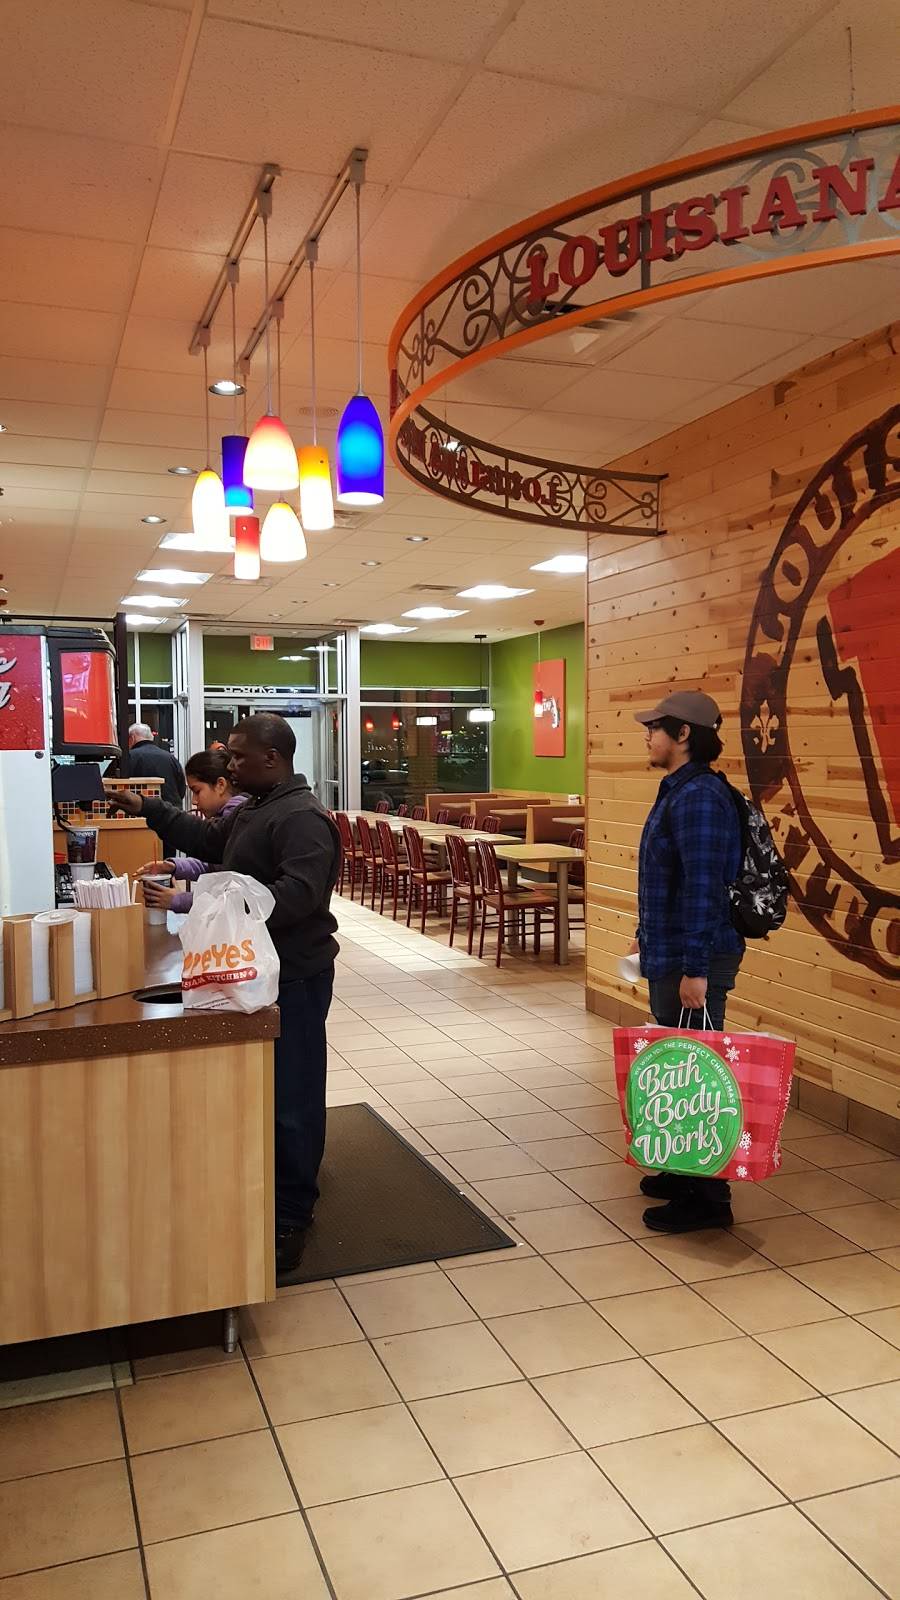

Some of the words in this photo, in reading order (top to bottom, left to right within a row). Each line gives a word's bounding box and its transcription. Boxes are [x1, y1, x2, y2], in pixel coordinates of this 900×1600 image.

[638, 1052, 704, 1097] Bath
[663, 1041, 677, 1049] THE
[678, 1041, 710, 1060] PERFECT
[710, 1058, 736, 1104] CHRISTMAS
[644, 1083, 738, 1128] Body
[634, 1120, 723, 1165] Works
